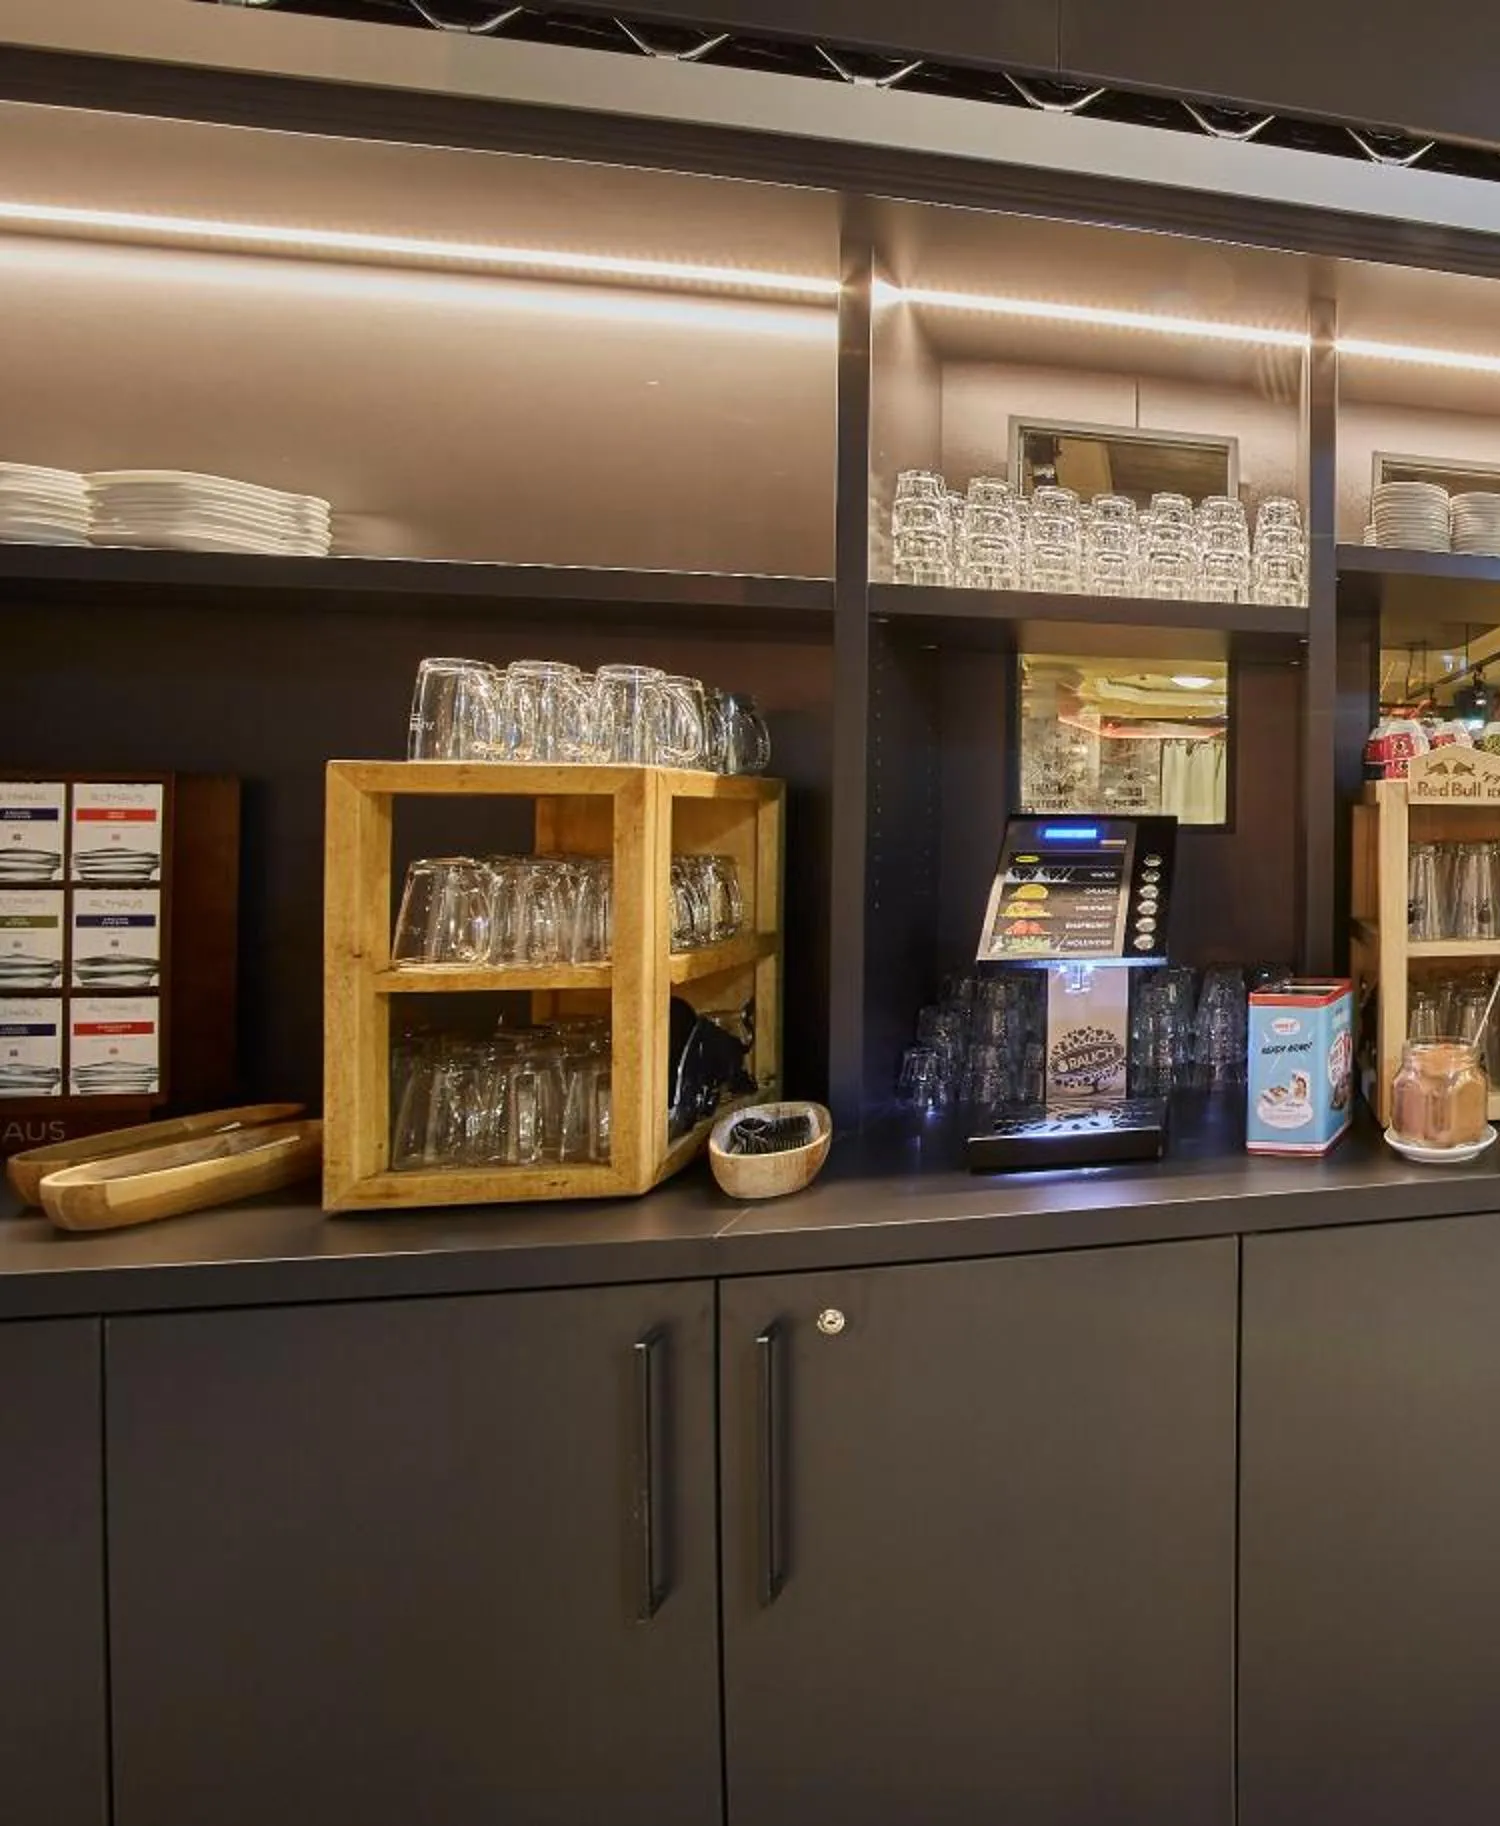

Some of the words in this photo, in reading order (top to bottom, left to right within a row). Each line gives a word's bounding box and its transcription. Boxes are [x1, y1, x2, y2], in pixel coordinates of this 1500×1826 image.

[1417, 781, 1449, 797] Red
[1451, 782, 1482, 797] Bull
[1069, 1046, 1116, 1070] RAUCH
[2, 1121, 65, 1144] AUS
